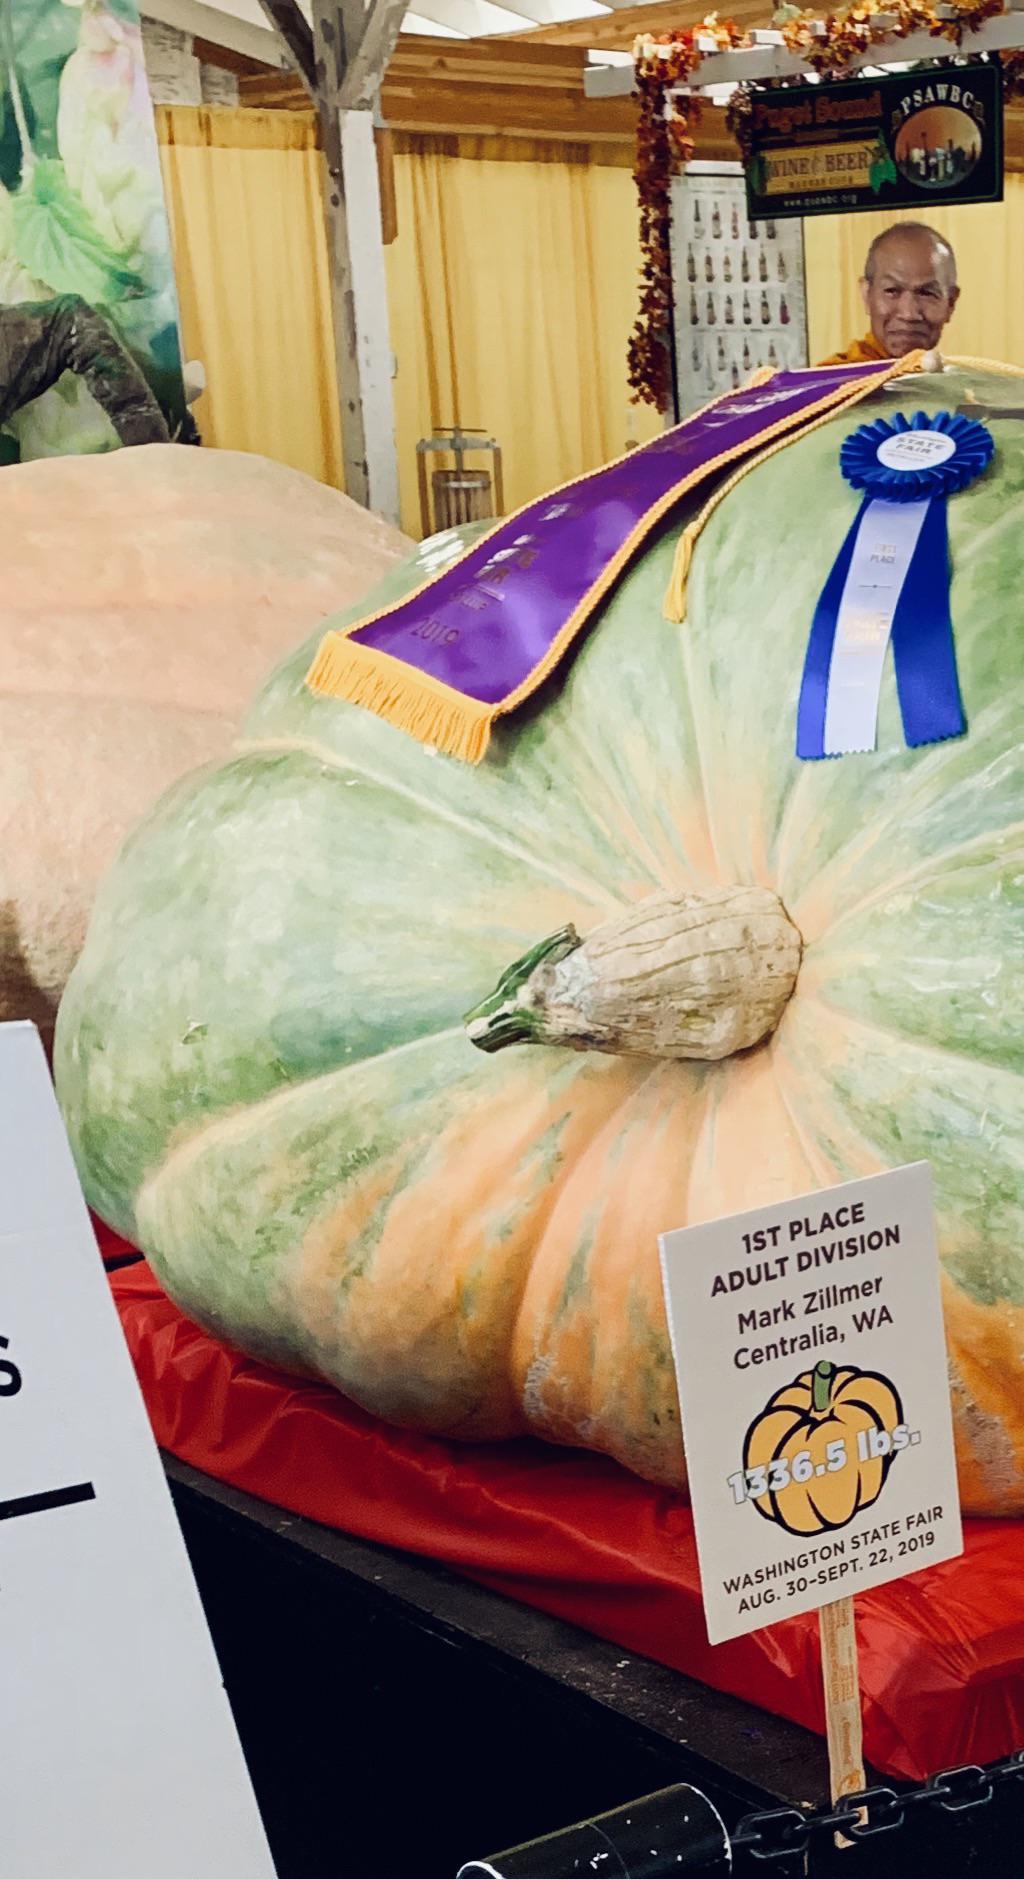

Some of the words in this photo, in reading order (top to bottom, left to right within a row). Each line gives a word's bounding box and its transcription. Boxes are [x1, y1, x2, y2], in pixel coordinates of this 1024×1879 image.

[901, 83, 974, 115] PSAWBC
[825, 152, 868, 172] BEER
[896, 437, 946, 450] STATE
[896, 443, 931, 454] FAIR
[741, 1226, 781, 1254] 1ST
[789, 1202, 866, 1242] PLACE
[710, 1257, 791, 1297] ADULT
[797, 1225, 900, 1272] DIVISION
[737, 1299, 795, 1334] Mark
[803, 1276, 883, 1314] Zillmer
[733, 1322, 846, 1371] Centralia,
[852, 1304, 894, 1333] WA
[726, 1439, 847, 1505] 1336.5
[857, 1423, 921, 1462] lbs.
[722, 1540, 846, 1596] WASHINGTON
[850, 1520, 902, 1551] STATE
[906, 1505, 944, 1533] FAIR
[737, 1582, 782, 1615] AUG.
[868, 1548, 894, 1569] 22,
[898, 1532, 935, 1557] 2019
